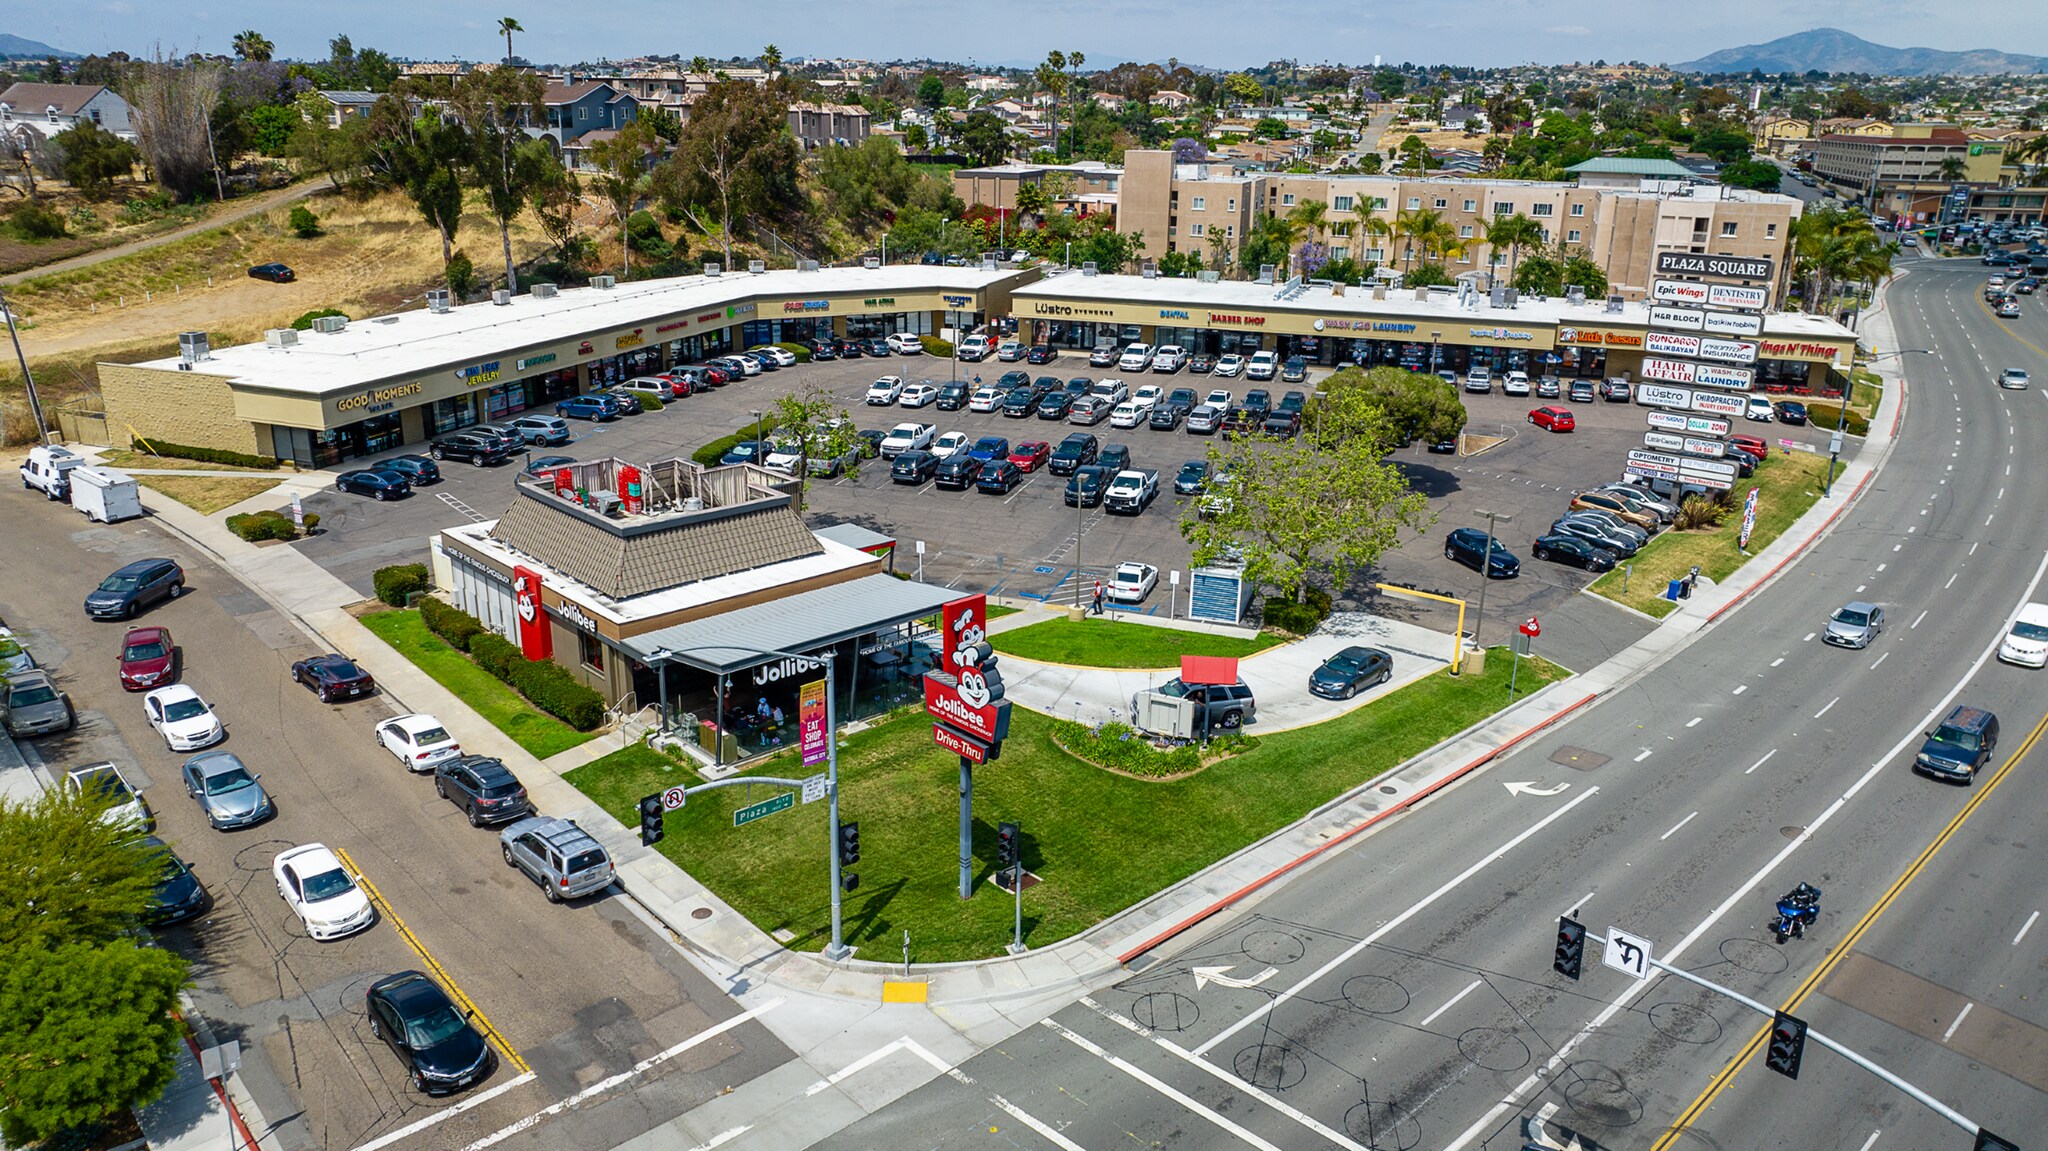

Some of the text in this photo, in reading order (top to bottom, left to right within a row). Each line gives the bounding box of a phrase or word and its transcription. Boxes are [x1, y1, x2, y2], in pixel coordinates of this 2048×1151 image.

[1661, 256, 1767, 276] PLAZA SQUARE
[1657, 285, 1704, 298] Epic Wings
[1713, 288, 1762, 300] DENTISTRY
[1035, 302, 1072, 315] Lüstro
[1159, 310, 1189, 320] DENTAL
[1211, 314, 1266, 326] BARBER SHOP
[1673, 315, 1700, 323] BLOCK
[1372, 322, 1417, 333] LAUNDRY
[1578, 331, 1642, 345] Little Caesars
[1648, 334, 1698, 346] SUNCARGO
[1650, 344, 1694, 354] BALIKBAYAN
[1704, 344, 1740, 353] PRONTO
[1760, 340, 1786, 353] ings
[1800, 344, 1838, 356] Things
[1702, 350, 1752, 360] INSURANCE
[1652, 360, 1685, 372] HAIR
[467, 371, 500, 386] JEWELRY
[1644, 368, 1692, 381] AFFAIR
[1698, 375, 1747, 387] LAUNDRY
[338, 382, 422, 411] GOOD MOMENTS
[1646, 387, 1683, 400] Lüstro
[1695, 393, 1743, 407] CHIROPRACTOR
[1698, 402, 1736, 412] INJURY EXPERTS
[1688, 420, 1709, 429] DOLLAR
[1711, 423, 1727, 432] ZONE
[1633, 452, 1675, 464] OPTOMETRY
[1628, 468, 1678, 480] HOLLYWOOD MUSIC
[557, 600, 597, 632] Jollibee
[935, 694, 983, 727] Jollibee
[807, 720, 819, 731] EAT
[805, 730, 822, 743] SHOP
[936, 729, 981, 760] Drive-Thru
[740, 807, 767, 821] Plaza
